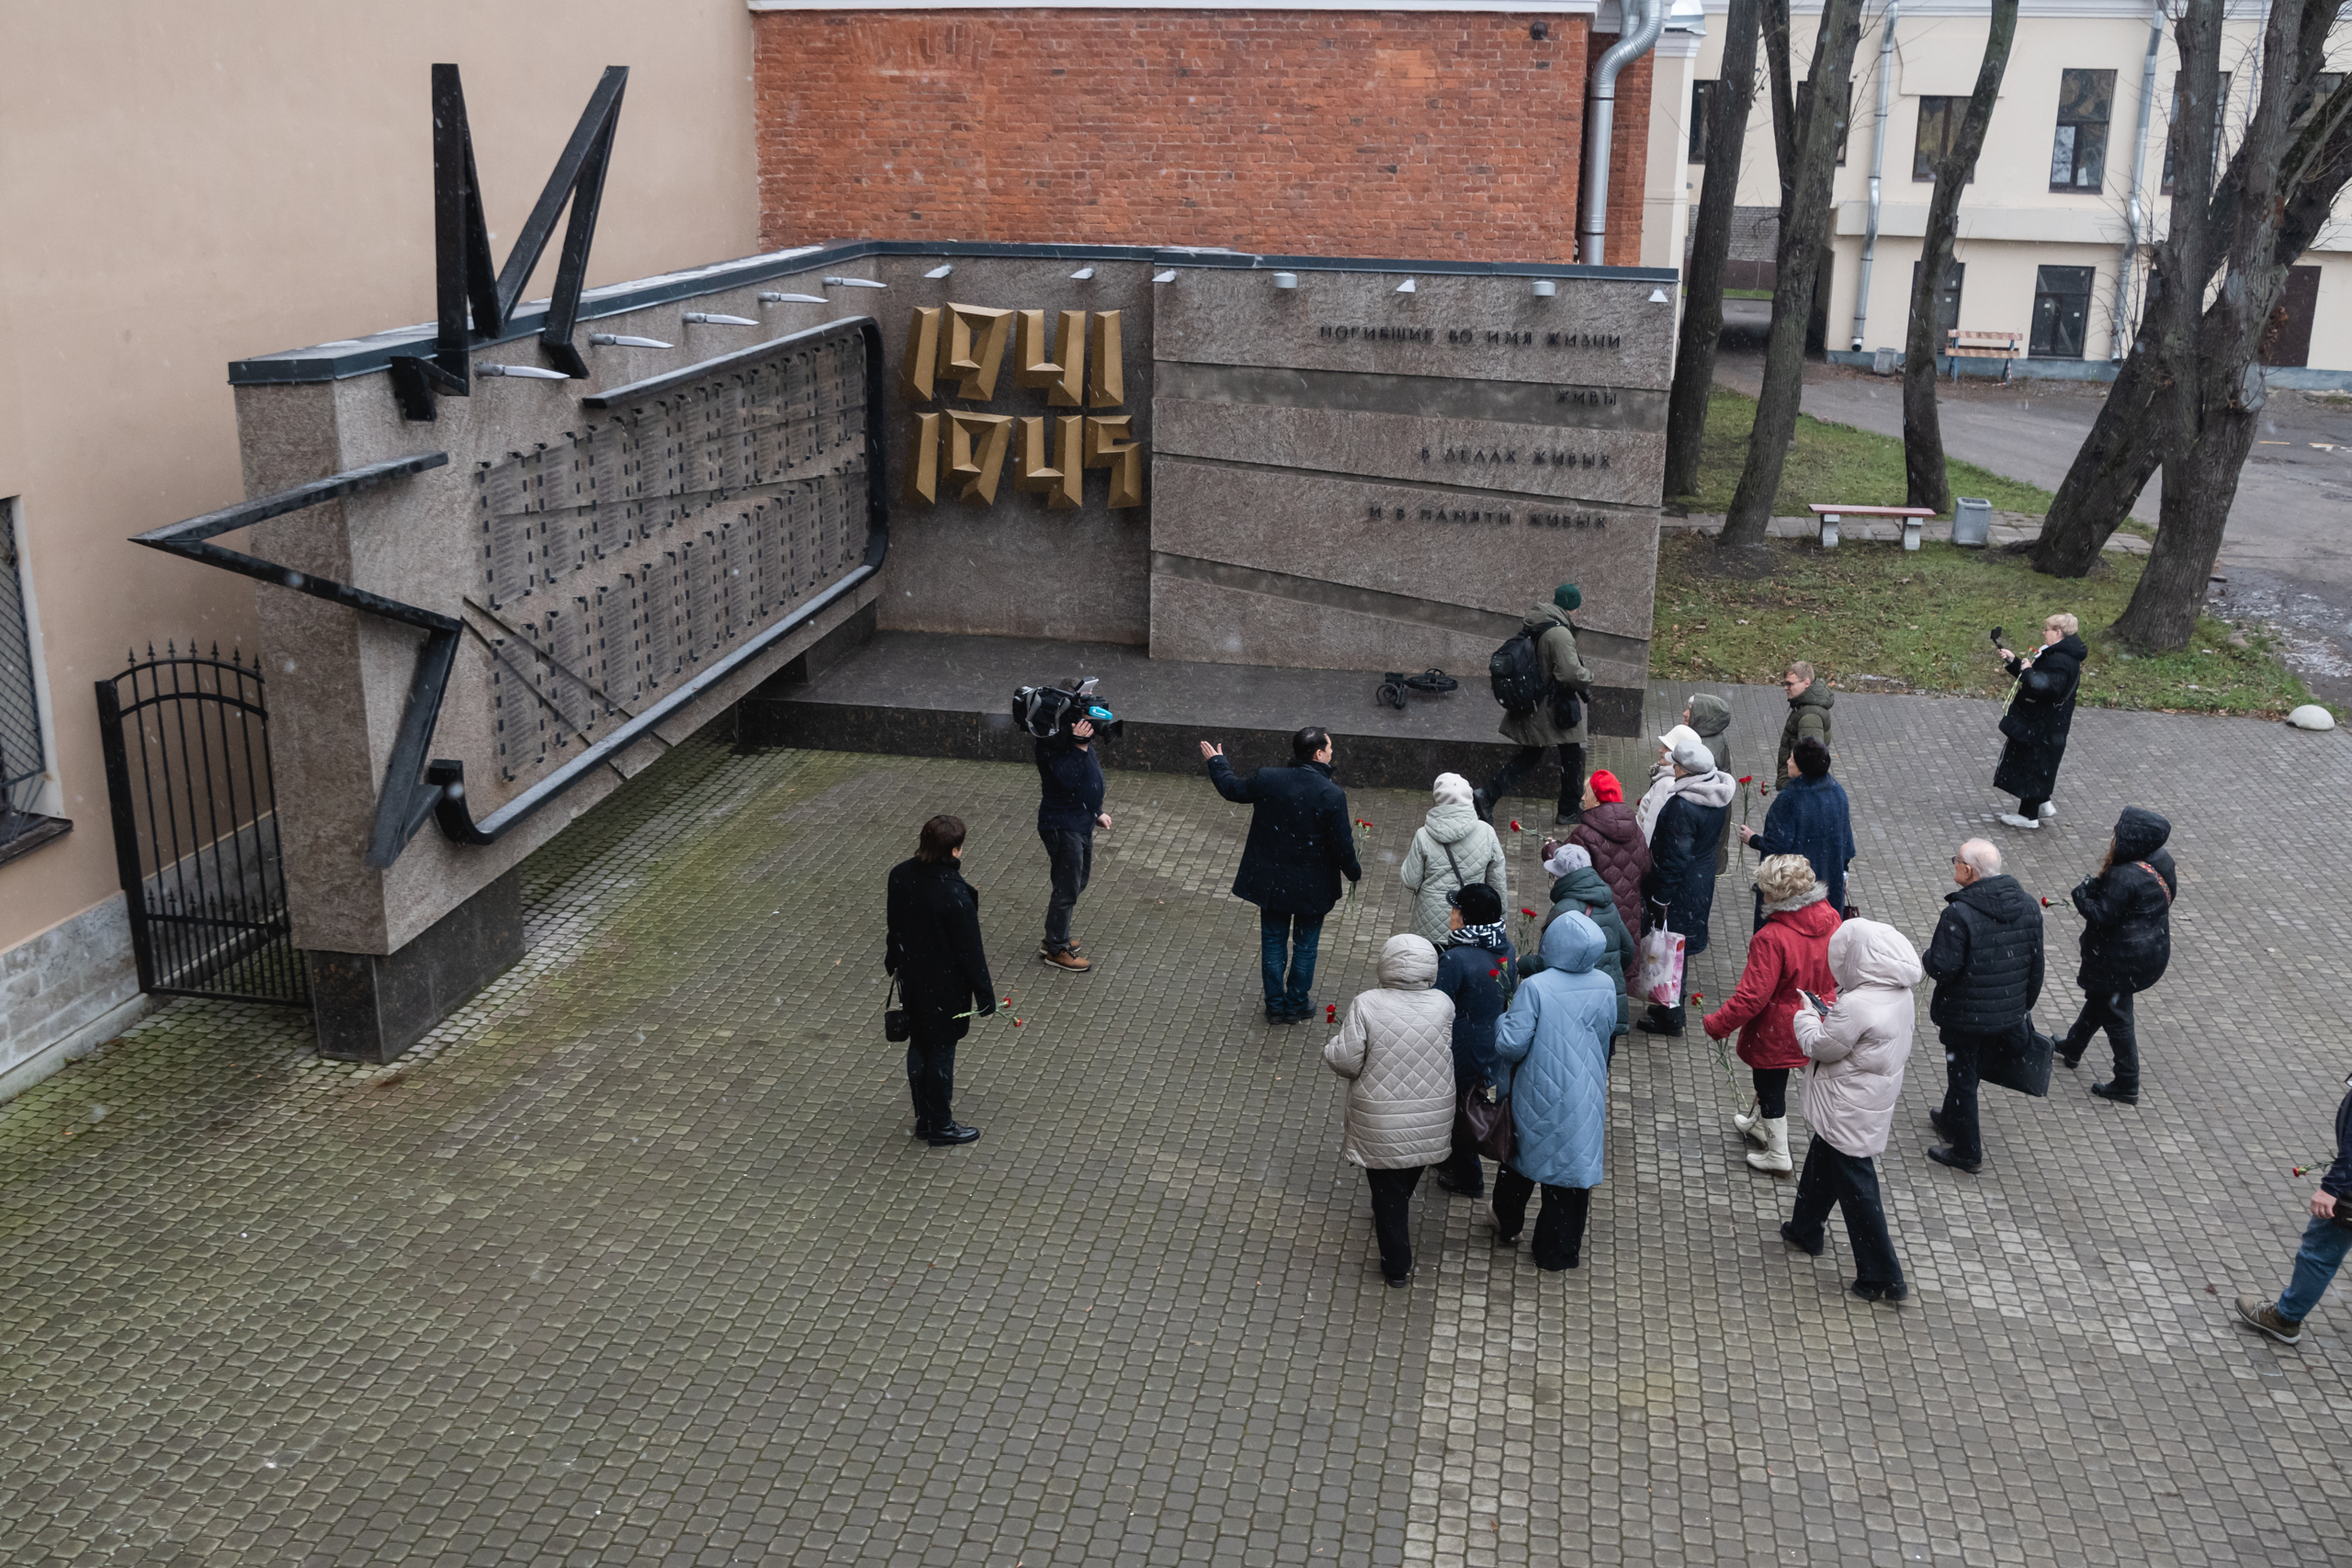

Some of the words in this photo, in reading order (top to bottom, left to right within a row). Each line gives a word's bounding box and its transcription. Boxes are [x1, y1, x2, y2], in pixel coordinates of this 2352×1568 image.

[1319, 324, 1435, 344] ПОГИБШИЕ
[1448, 328, 1473, 344] ВО
[1487, 330, 1533, 345] ИМЯ
[1546, 331, 1621, 348] ЖИЗНИ
[899, 302, 1125, 408] 1941
[1557, 389, 1617, 405] ЖИВЫ
[902, 409, 1142, 509] 1945
[1421, 447, 1430, 460] В
[1444, 447, 1516, 464] ДЕЛАХ
[1532, 450, 1611, 467] ЖИВЫХ
[1370, 505, 1381, 519] И
[1396, 507, 1406, 521] В
[1420, 508, 1510, 525] ПАМЯТИ
[1528, 513, 1606, 529] ЖИВЫХ
